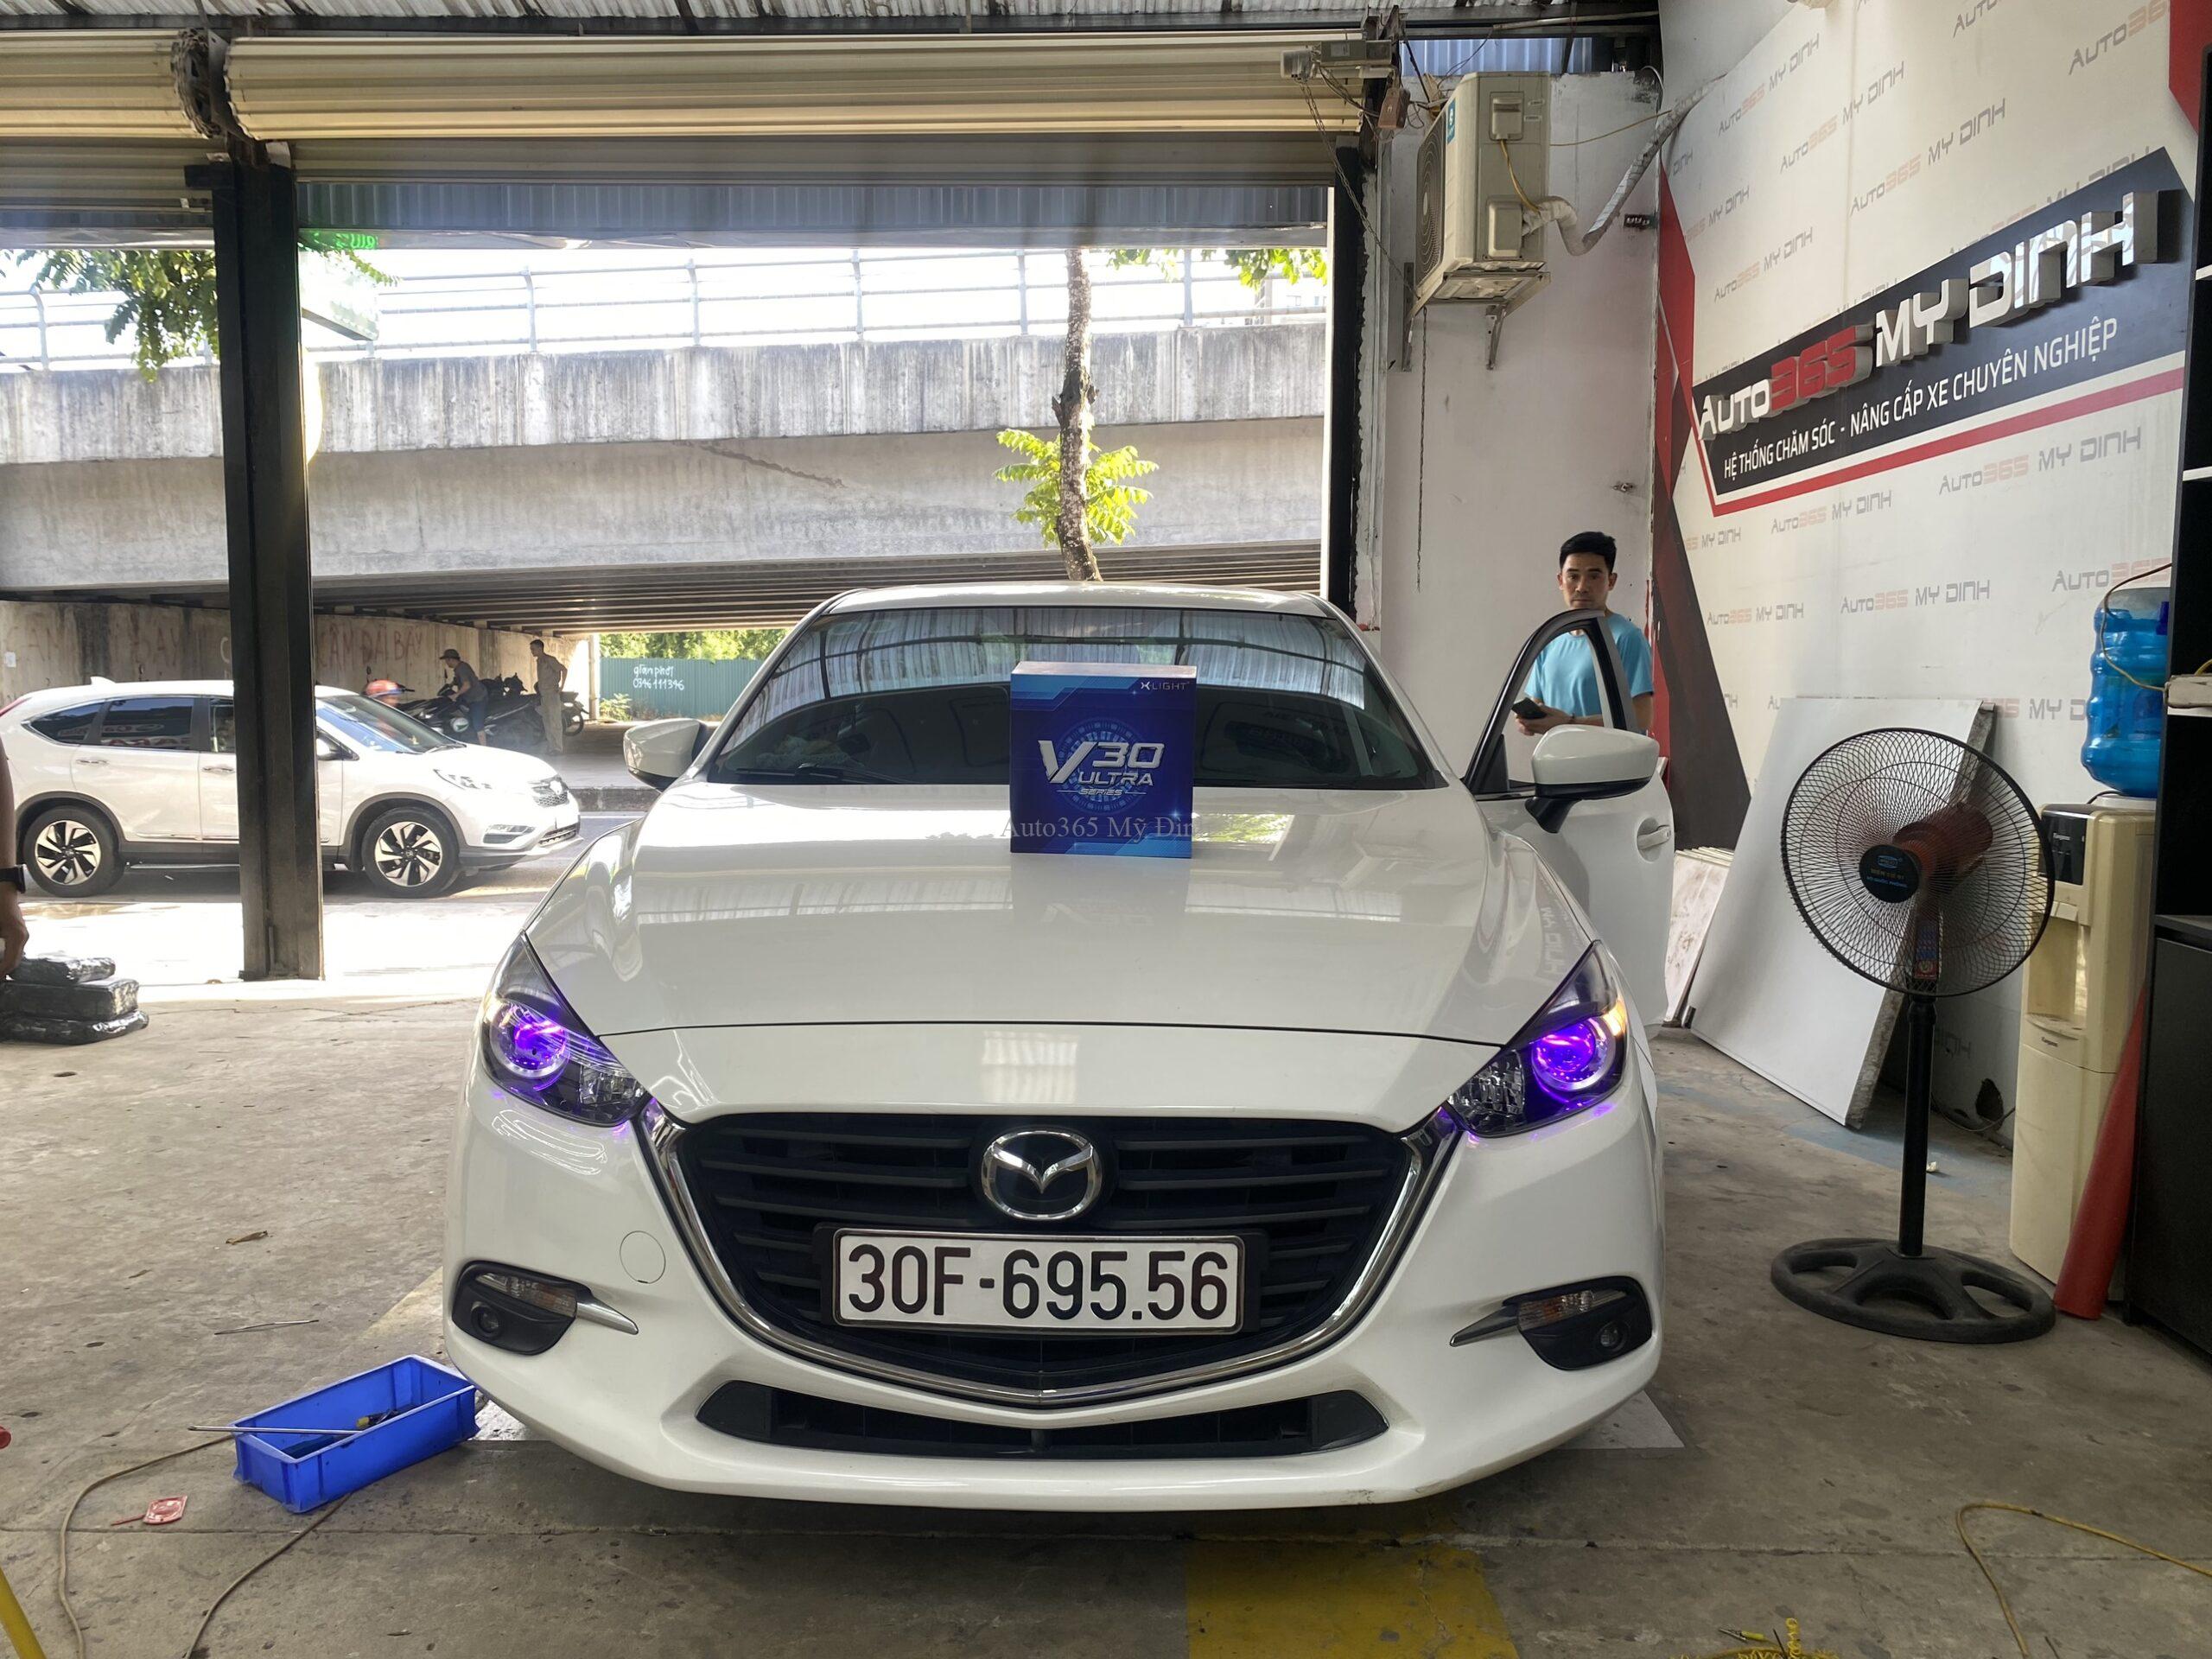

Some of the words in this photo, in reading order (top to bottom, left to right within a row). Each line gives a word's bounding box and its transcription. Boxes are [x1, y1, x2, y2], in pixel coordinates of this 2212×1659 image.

[1769, 63, 1787, 92] MY
[1789, 33, 1820, 73] DINH
[1842, 92, 1864, 124] MY
[1867, 60, 1904, 105] DINH
[1928, 131, 1954, 165] MY
[1959, 98, 2005, 145] DINH
[1708, 205, 1724, 226] MY
[1726, 185, 1749, 214] DINH
[1764, 247, 1781, 272] MY
[1783, 226, 1813, 259] DINH
[1876, 278, 1950, 366] MY
[1969, 192, 2136, 328] DINH
[1724, 451, 1737, 480] HỆ
[1738, 439, 1774, 474] THỐNG
[1776, 431, 1808, 461] CHĂM
[1811, 418, 1835, 448] SÓC
[1850, 401, 1890, 436] NÂNG
[1893, 379, 1923, 419] CẤP
[1927, 378, 1948, 410] XE
[1953, 348, 2028, 400] CHUYÊN
[2034, 315, 2117, 374] NGHIỆP
[1939, 454, 2029, 495] AUTO365
[2038, 443, 2072, 472] MY
[2080, 427, 2140, 462] DINH
[1832, 503, 1852, 520] MY
[1856, 490, 1891, 513] DINH
[1701, 532, 1714, 549] MY
[1718, 527, 1741, 545] DINH
[1756, 607, 1771, 621] MY
[1776, 602, 1804, 620] DINH
[1916, 585, 1940, 607] MY
[1946, 580, 1990, 602] DINH
[2030, 698, 2063, 720] MY
[1038, 740, 1166, 784] V30
[1079, 771, 1154, 786] ULTRA
[848, 1243, 1229, 1321] 30F-695.56
